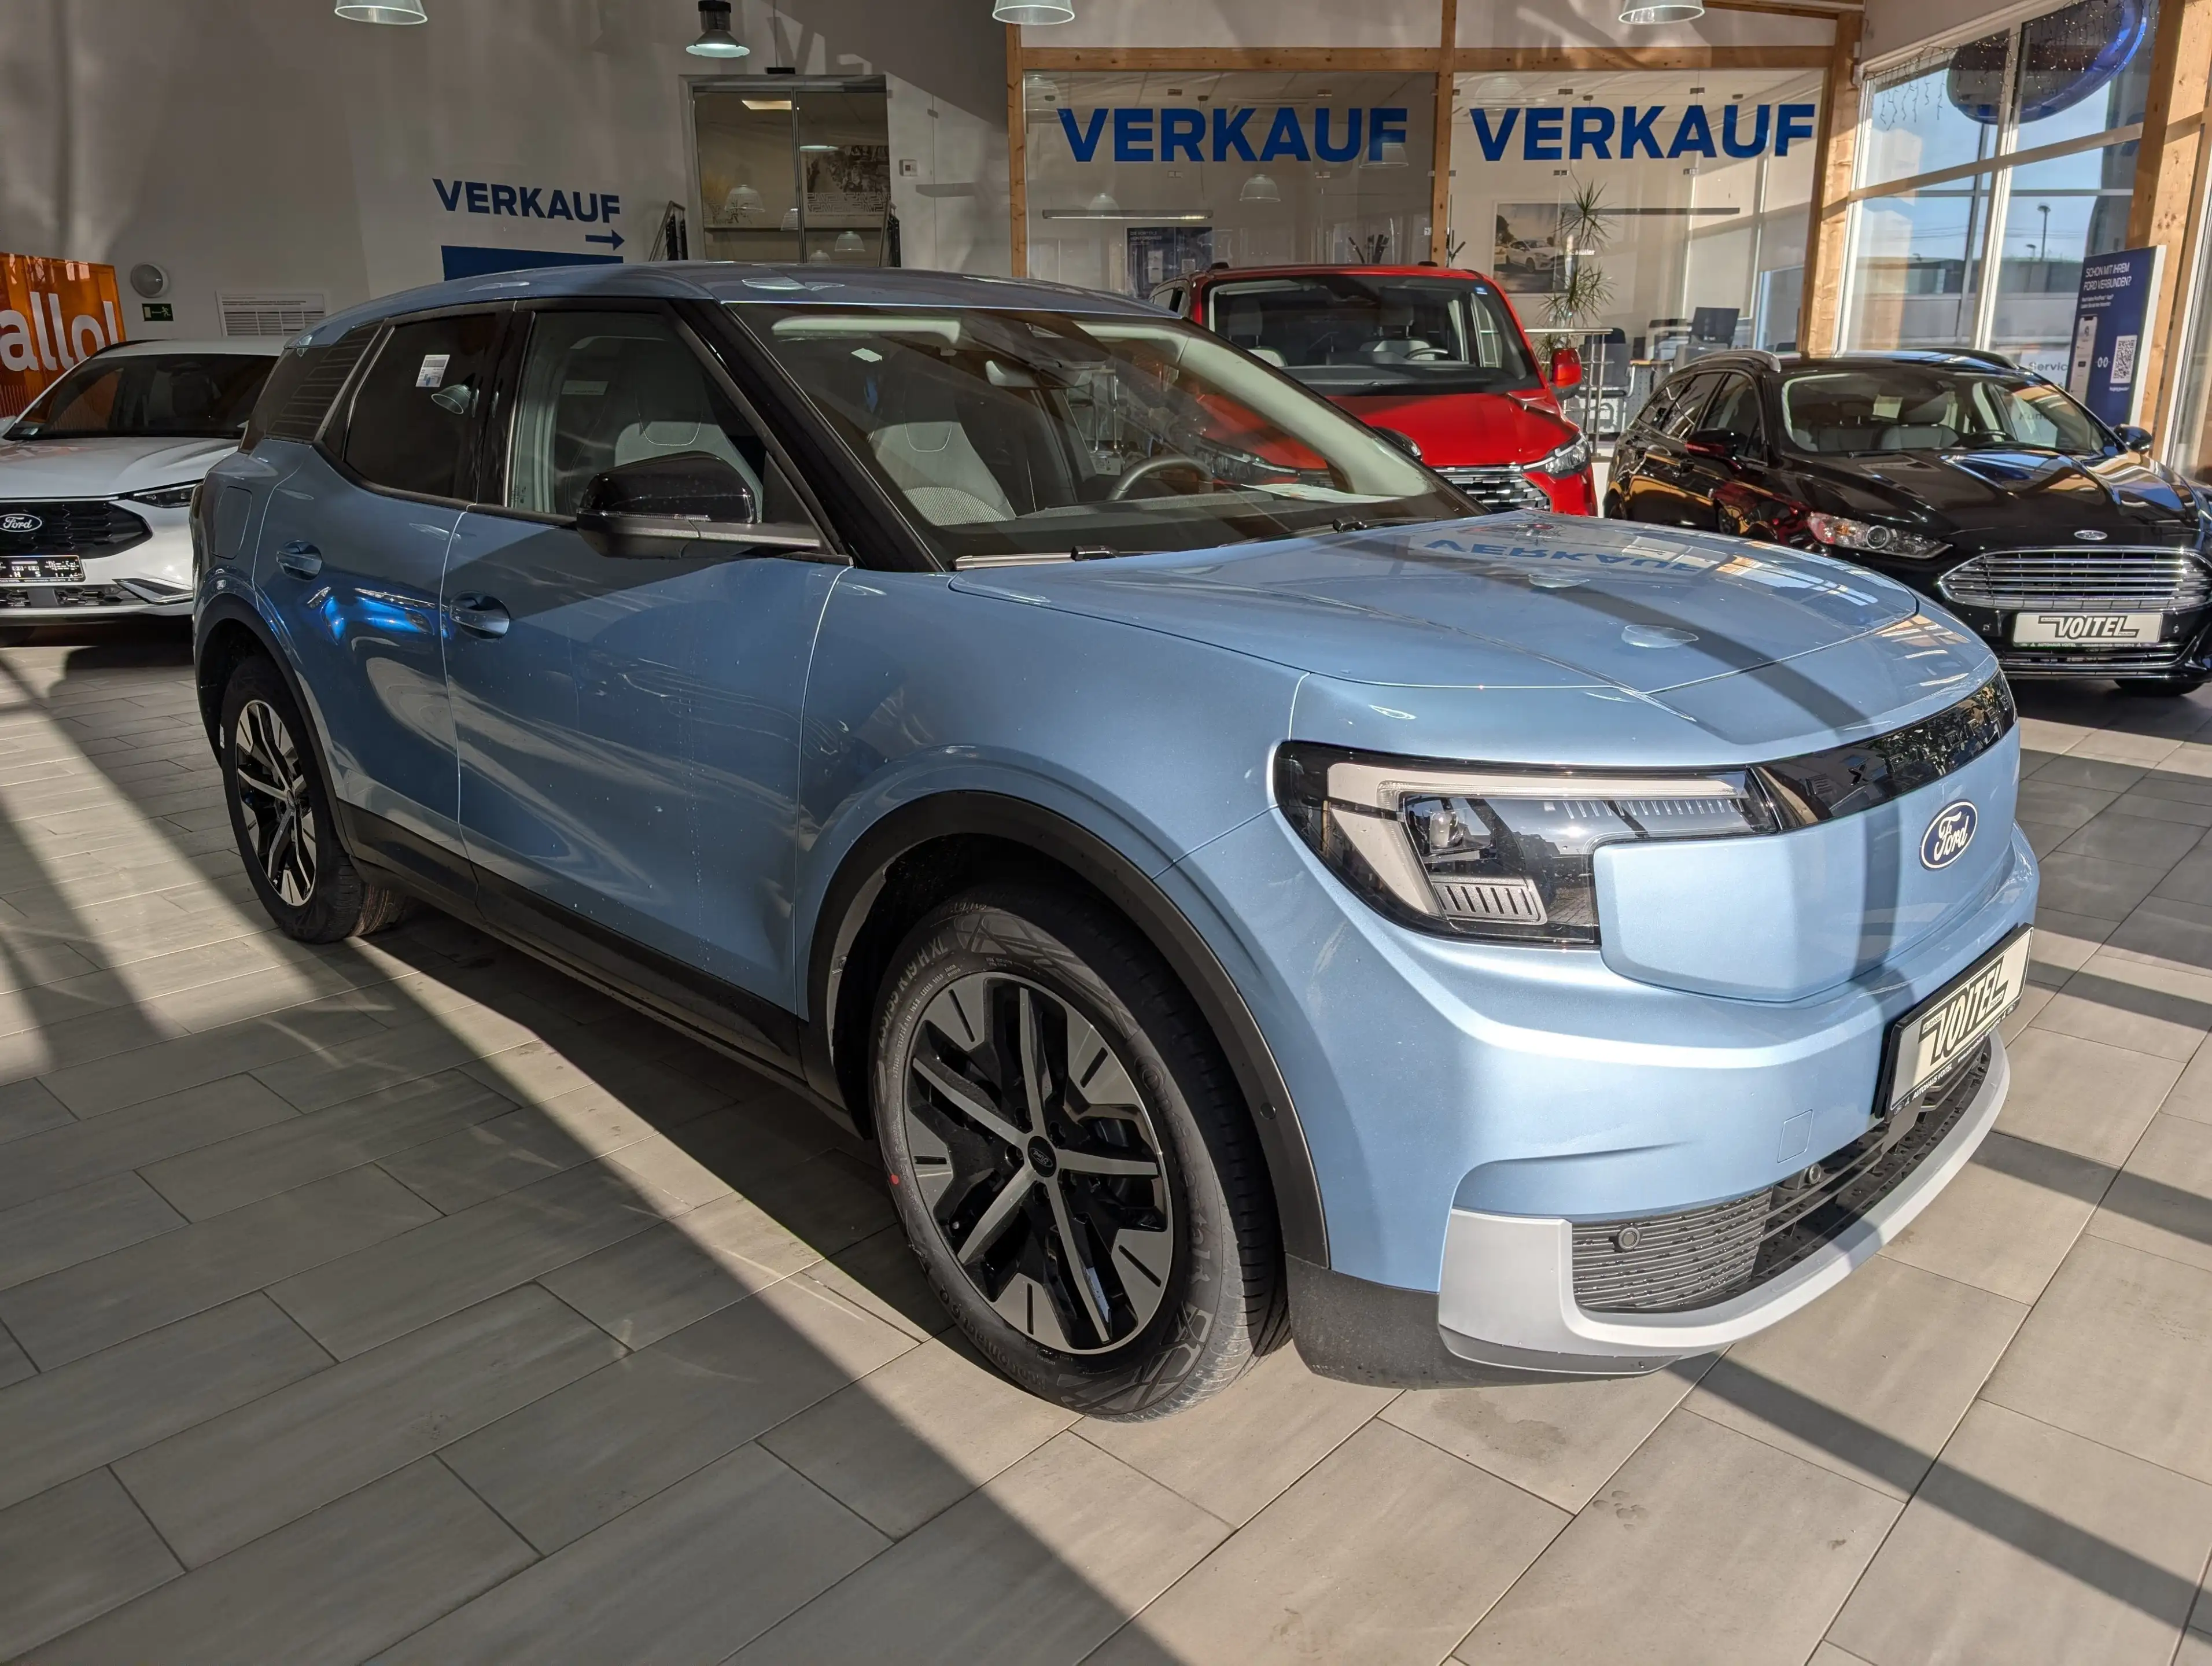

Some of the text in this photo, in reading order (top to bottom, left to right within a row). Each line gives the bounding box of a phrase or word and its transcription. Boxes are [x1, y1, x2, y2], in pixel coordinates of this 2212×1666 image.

[1057, 108, 1408, 162] VERKAUF
[1470, 104, 1816, 161] VERKAUF
[432, 178, 620, 223] VERKAUF
[2083, 276, 2132, 290] FORD VERBUNDEN?
[2085, 262, 2130, 278] SCHON MIT IHREM
[3, 516, 33, 529] Ford
[2057, 617, 2129, 638] VOITEL
[1934, 811, 1970, 861] Ford
[1934, 963, 2002, 1058] VOITEL
[1912, 1063, 1953, 1101] AUTOHAUS VOITEL
